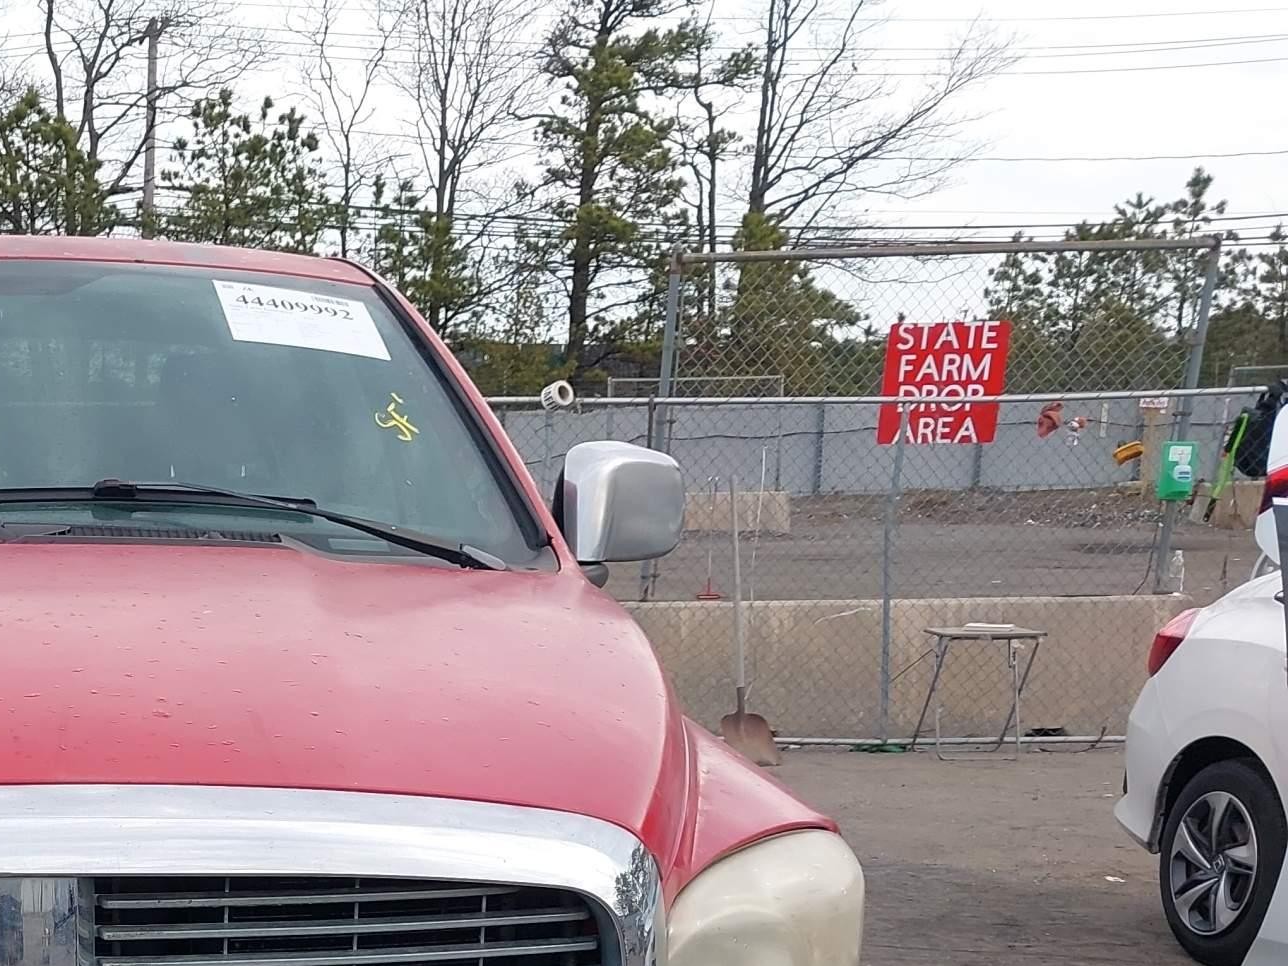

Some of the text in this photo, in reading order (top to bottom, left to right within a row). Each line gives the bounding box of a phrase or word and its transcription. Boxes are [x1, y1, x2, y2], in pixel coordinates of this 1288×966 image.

[235, 294, 354, 321] 44409992
[896, 320, 1001, 350] STATE
[898, 353, 992, 382] FARM
[896, 384, 985, 413] DROP
